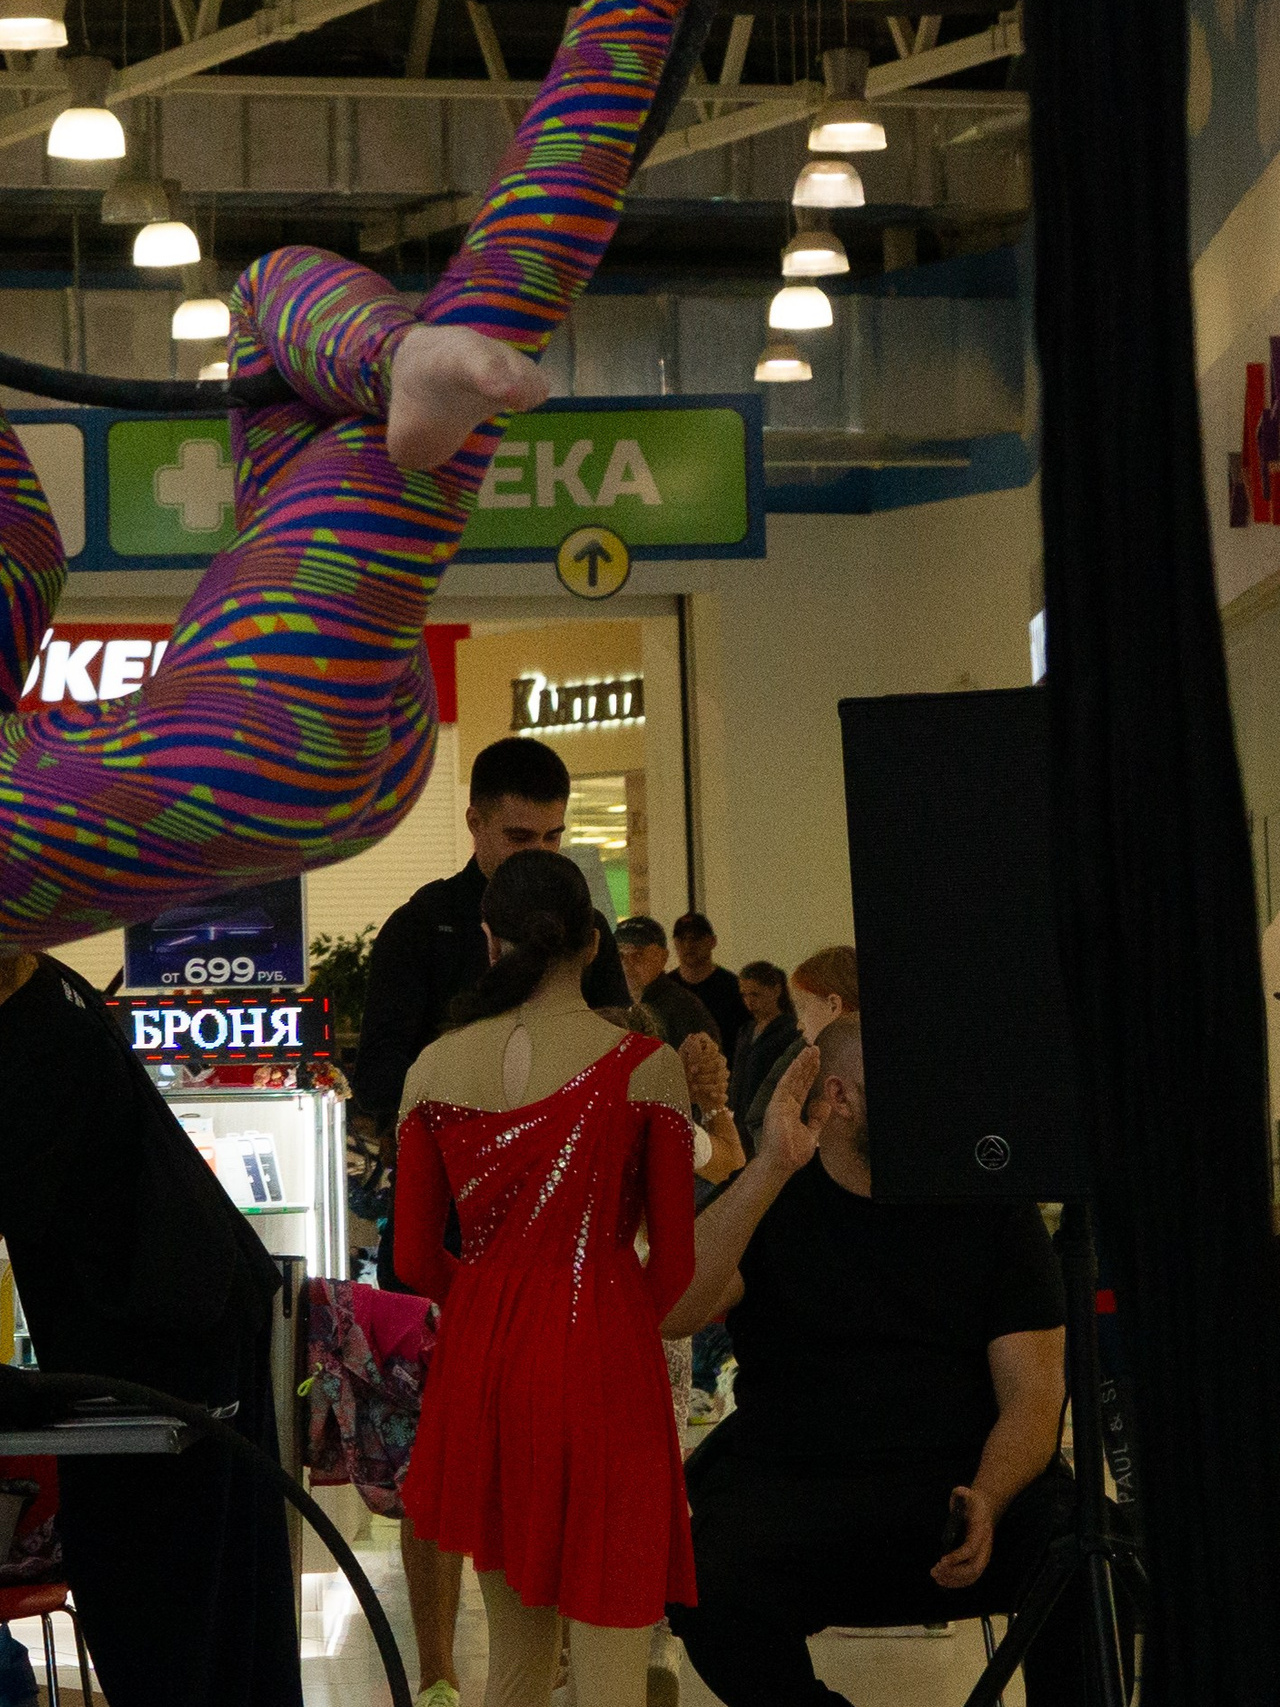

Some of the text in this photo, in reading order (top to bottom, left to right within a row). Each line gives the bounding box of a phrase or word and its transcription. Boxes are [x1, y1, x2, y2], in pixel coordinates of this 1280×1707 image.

[477, 439, 663, 509] ЕКА
[184, 957, 256, 984] 699
[131, 1007, 304, 1049] БРОНЯ
[1109, 1413, 1124, 1432] &
[1112, 1443, 1136, 1506] PAUL
